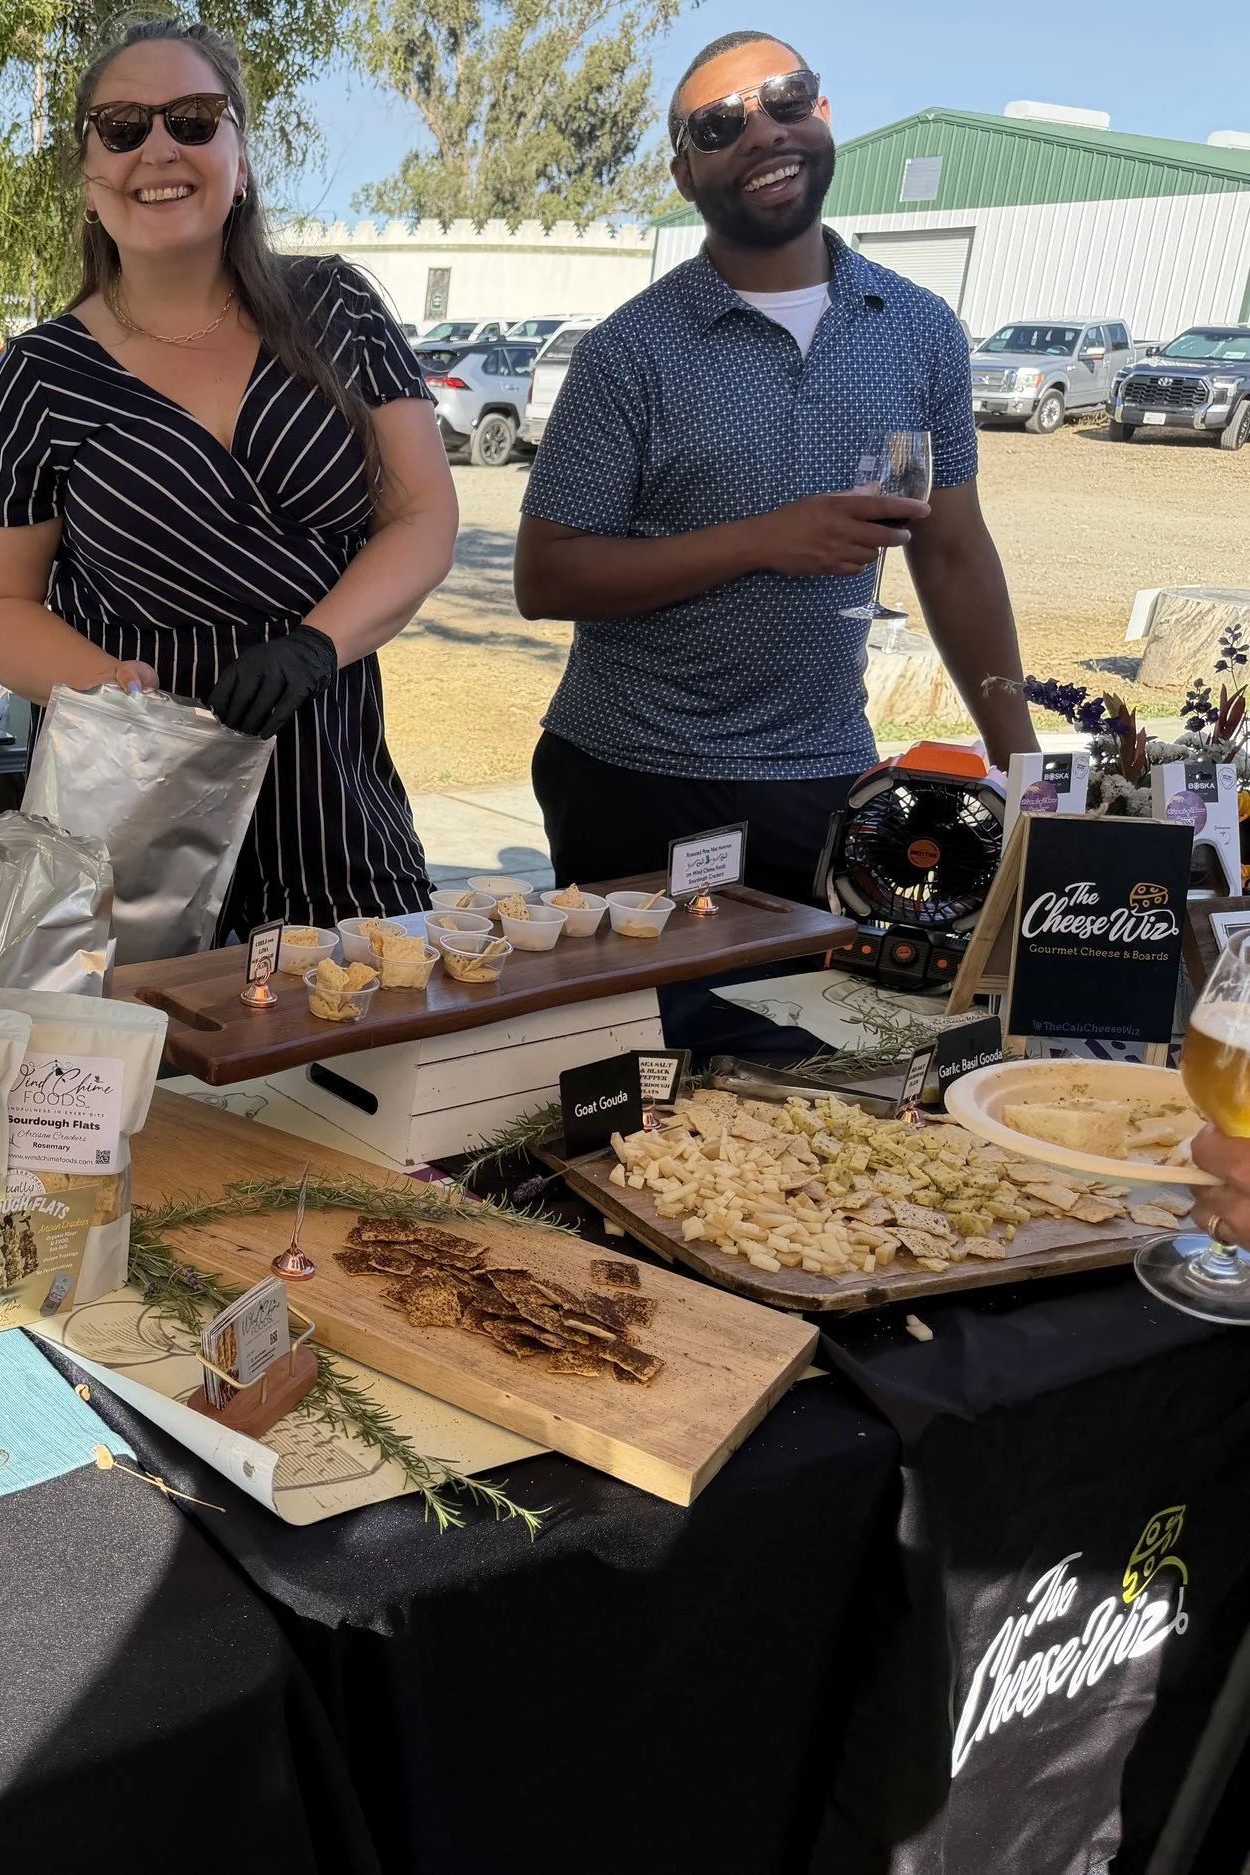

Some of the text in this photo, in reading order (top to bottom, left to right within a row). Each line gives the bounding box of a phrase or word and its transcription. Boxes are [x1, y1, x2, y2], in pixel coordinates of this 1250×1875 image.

[1044, 772, 1069, 781] BOSKA
[1187, 782, 1215, 790] BOSKA
[1065, 882, 1099, 907] The
[1021, 892, 1178, 943] Cheese Wiz
[1029, 944, 1168, 961] Gourmet Cheese & Boards
[939, 1063, 961, 1078] Garlic
[962, 1056, 978, 1071] Basil
[979, 1050, 1003, 1065] Gooda
[53, 1068, 114, 1097] Chime
[23, 1090, 86, 1108] FOODS
[574, 1091, 628, 1118] Goat Gouda
[8, 1115, 101, 1131] Sourdough Flats
[32, 1141, 71, 1152] Rosemary
[31, 1196, 70, 1220] FLATS
[1027, 1552, 1083, 1636] The
[951, 1592, 1177, 1778] Cheese Wiz
